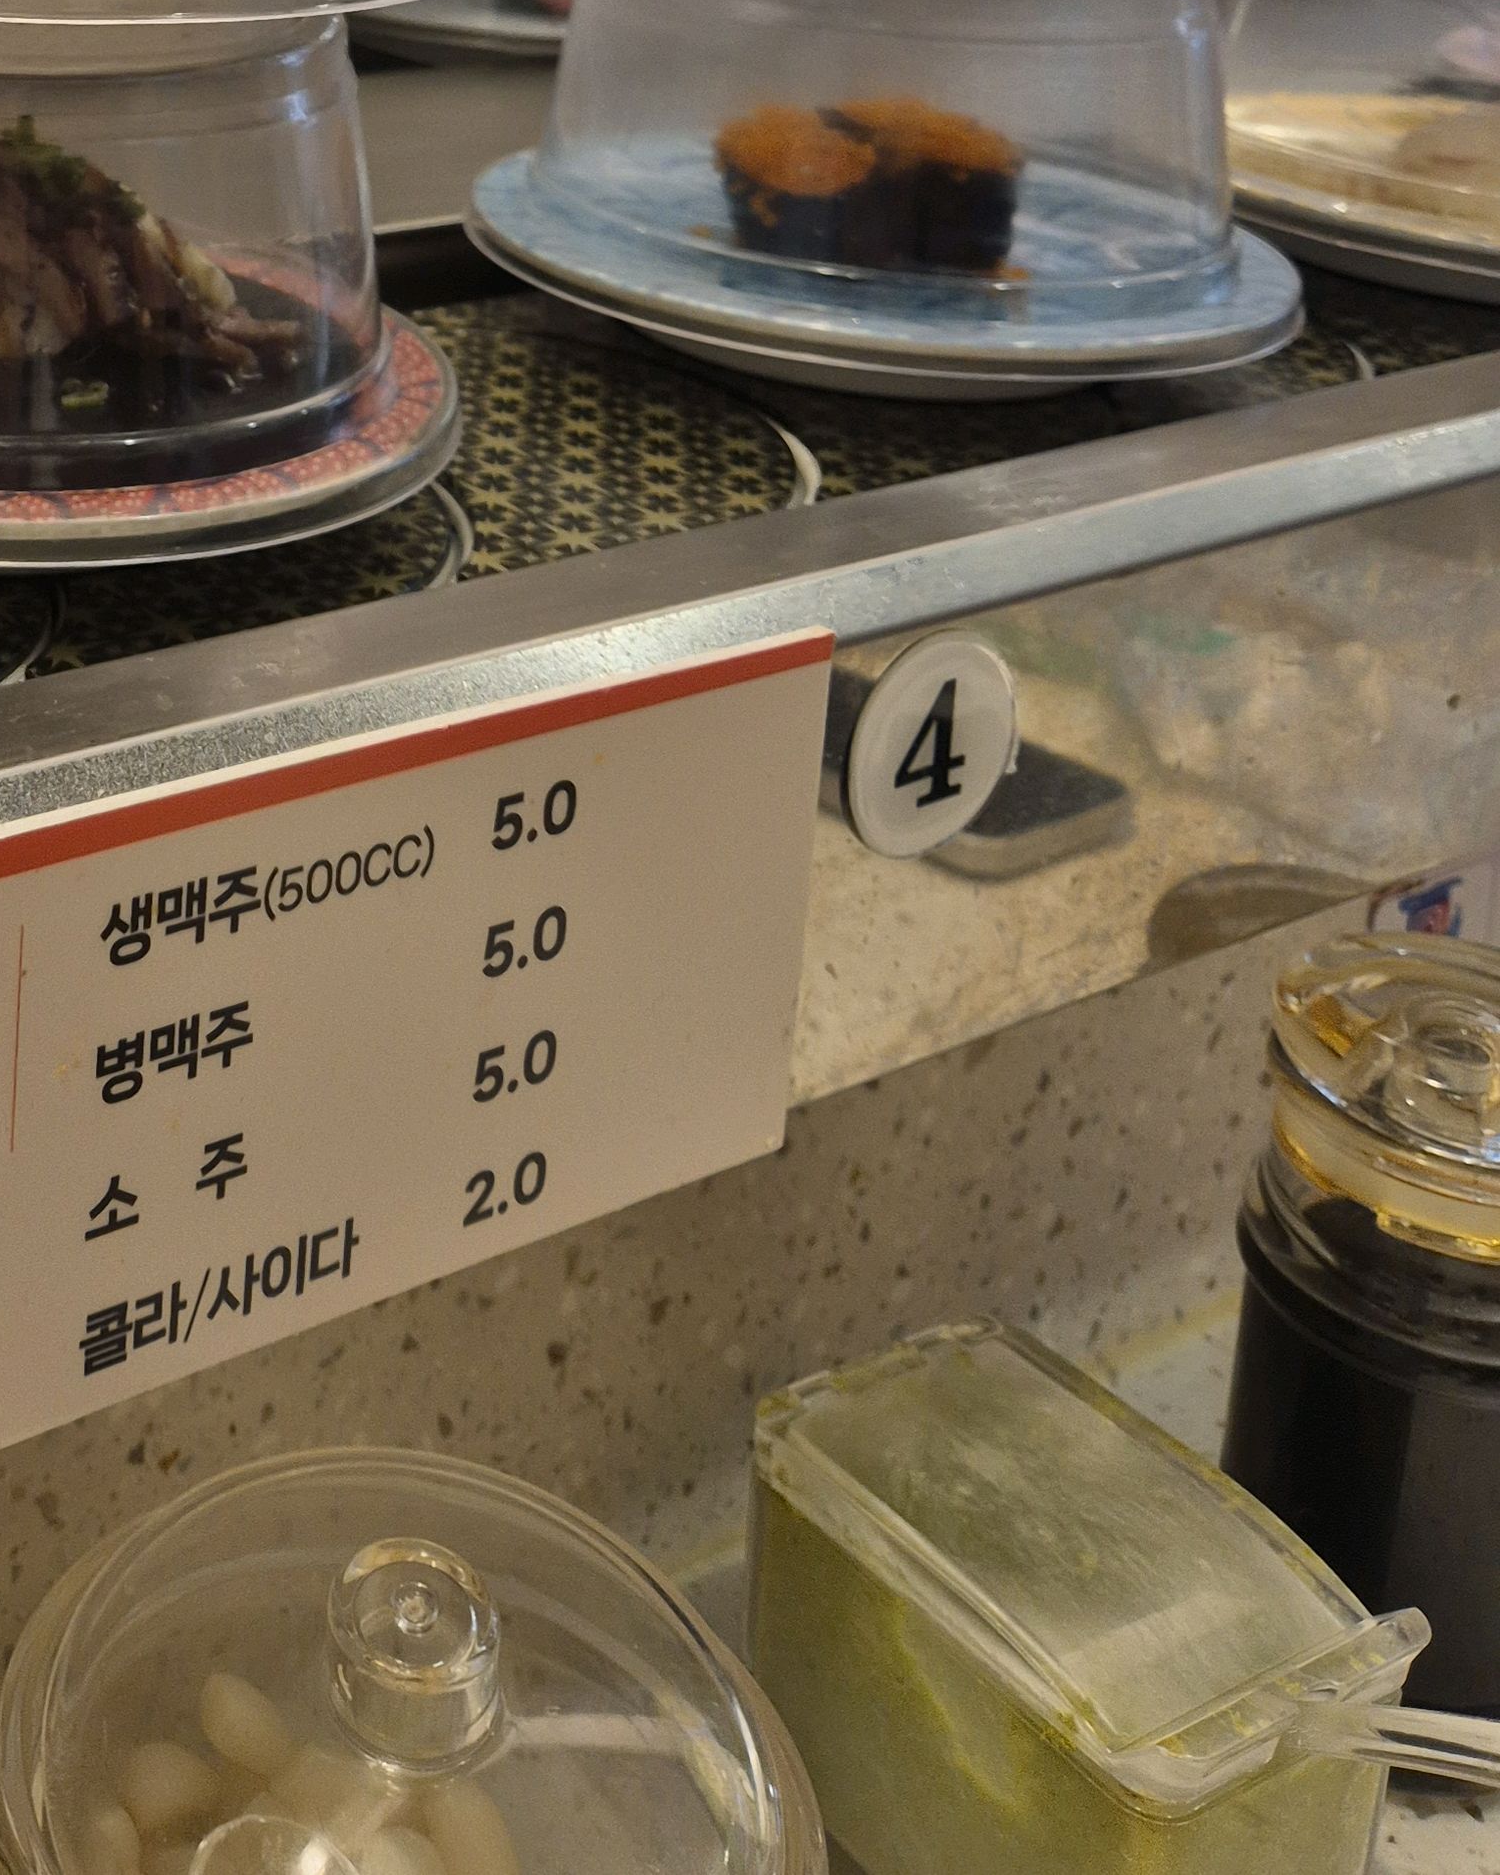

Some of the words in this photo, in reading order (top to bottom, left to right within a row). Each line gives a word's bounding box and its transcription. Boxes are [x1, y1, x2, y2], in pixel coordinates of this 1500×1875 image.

[894, 678, 966, 808] 4
[100, 825, 435, 966] 생맥주(500CC)
[492, 780, 577, 850] 5.0
[95, 1000, 254, 1105] 병맥주
[482, 905, 567, 978] 5.0
[472, 1029, 557, 1103] 5.0
[78, 1216, 360, 1377] 콜라/사이다
[463, 1151, 547, 1227] 2.0
